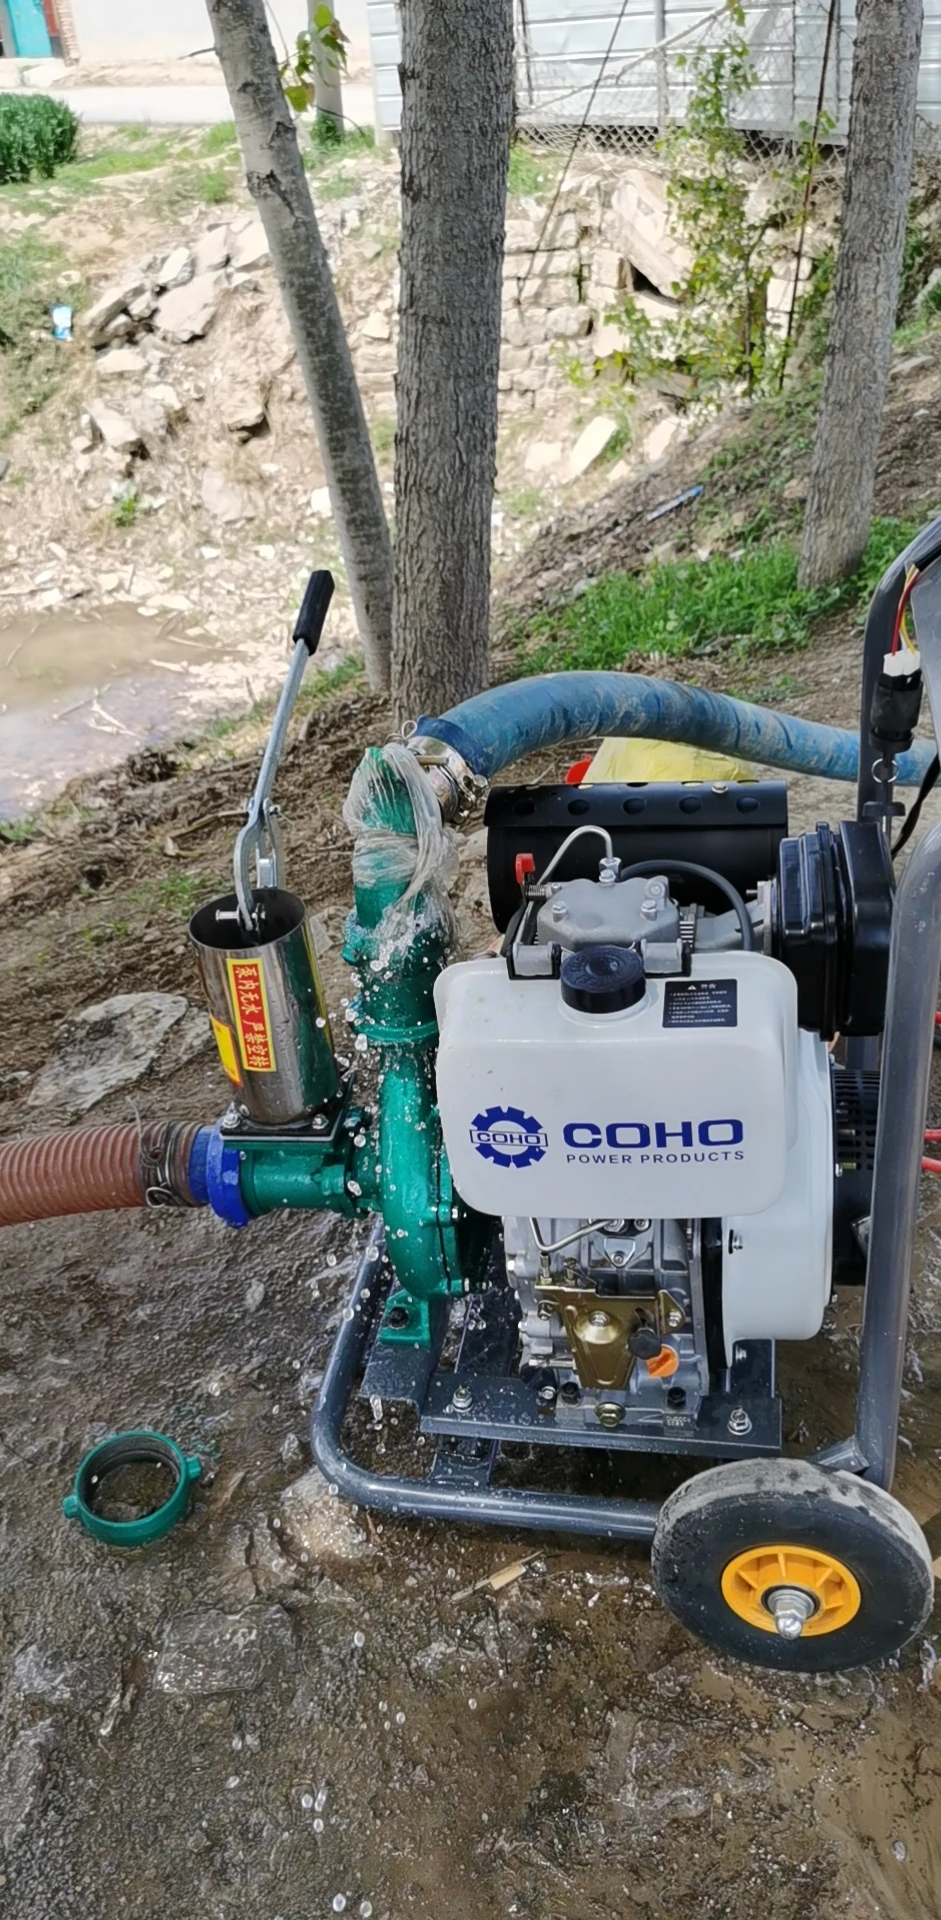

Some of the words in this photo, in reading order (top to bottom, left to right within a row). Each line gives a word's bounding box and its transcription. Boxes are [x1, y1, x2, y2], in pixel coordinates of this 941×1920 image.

[235, 966, 262, 1015] 泵内无水
[243, 1020, 270, 1068] 严禁空转
[476, 1132, 541, 1145] COHO
[563, 1119, 743, 1149] COHO
[567, 1154, 632, 1164] POWER
[641, 1151, 744, 1164] PRODUCTS
